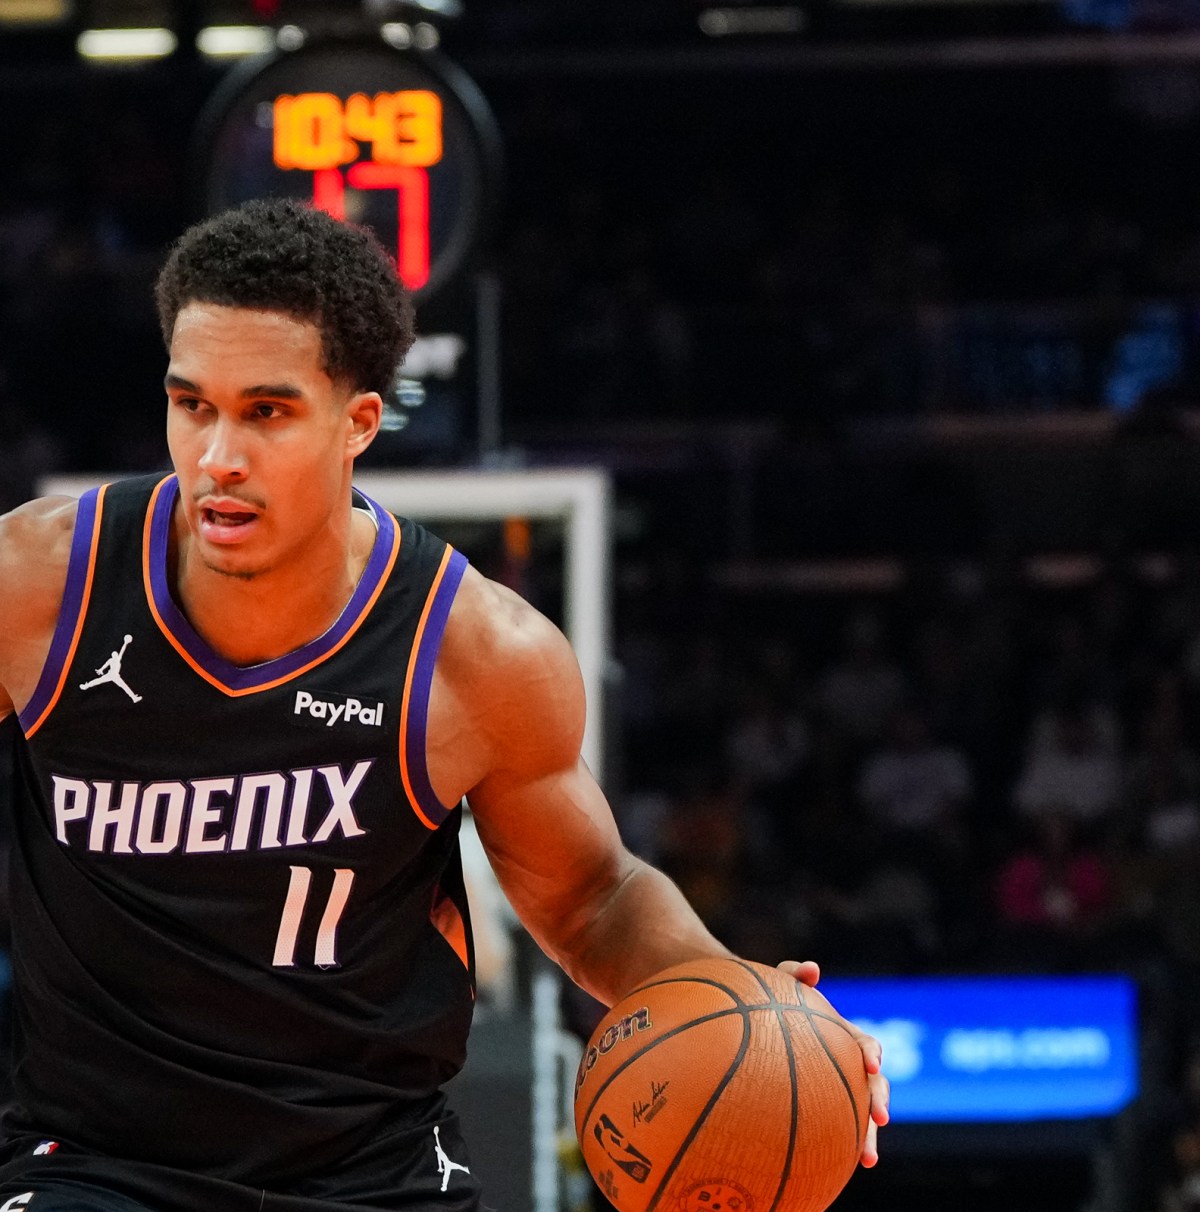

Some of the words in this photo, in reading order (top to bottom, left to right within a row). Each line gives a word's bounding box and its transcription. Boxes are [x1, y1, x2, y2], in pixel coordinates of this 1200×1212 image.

[293, 690, 385, 727] PayPal
[50, 757, 378, 855] PHOENIX
[272, 865, 356, 968] 11
